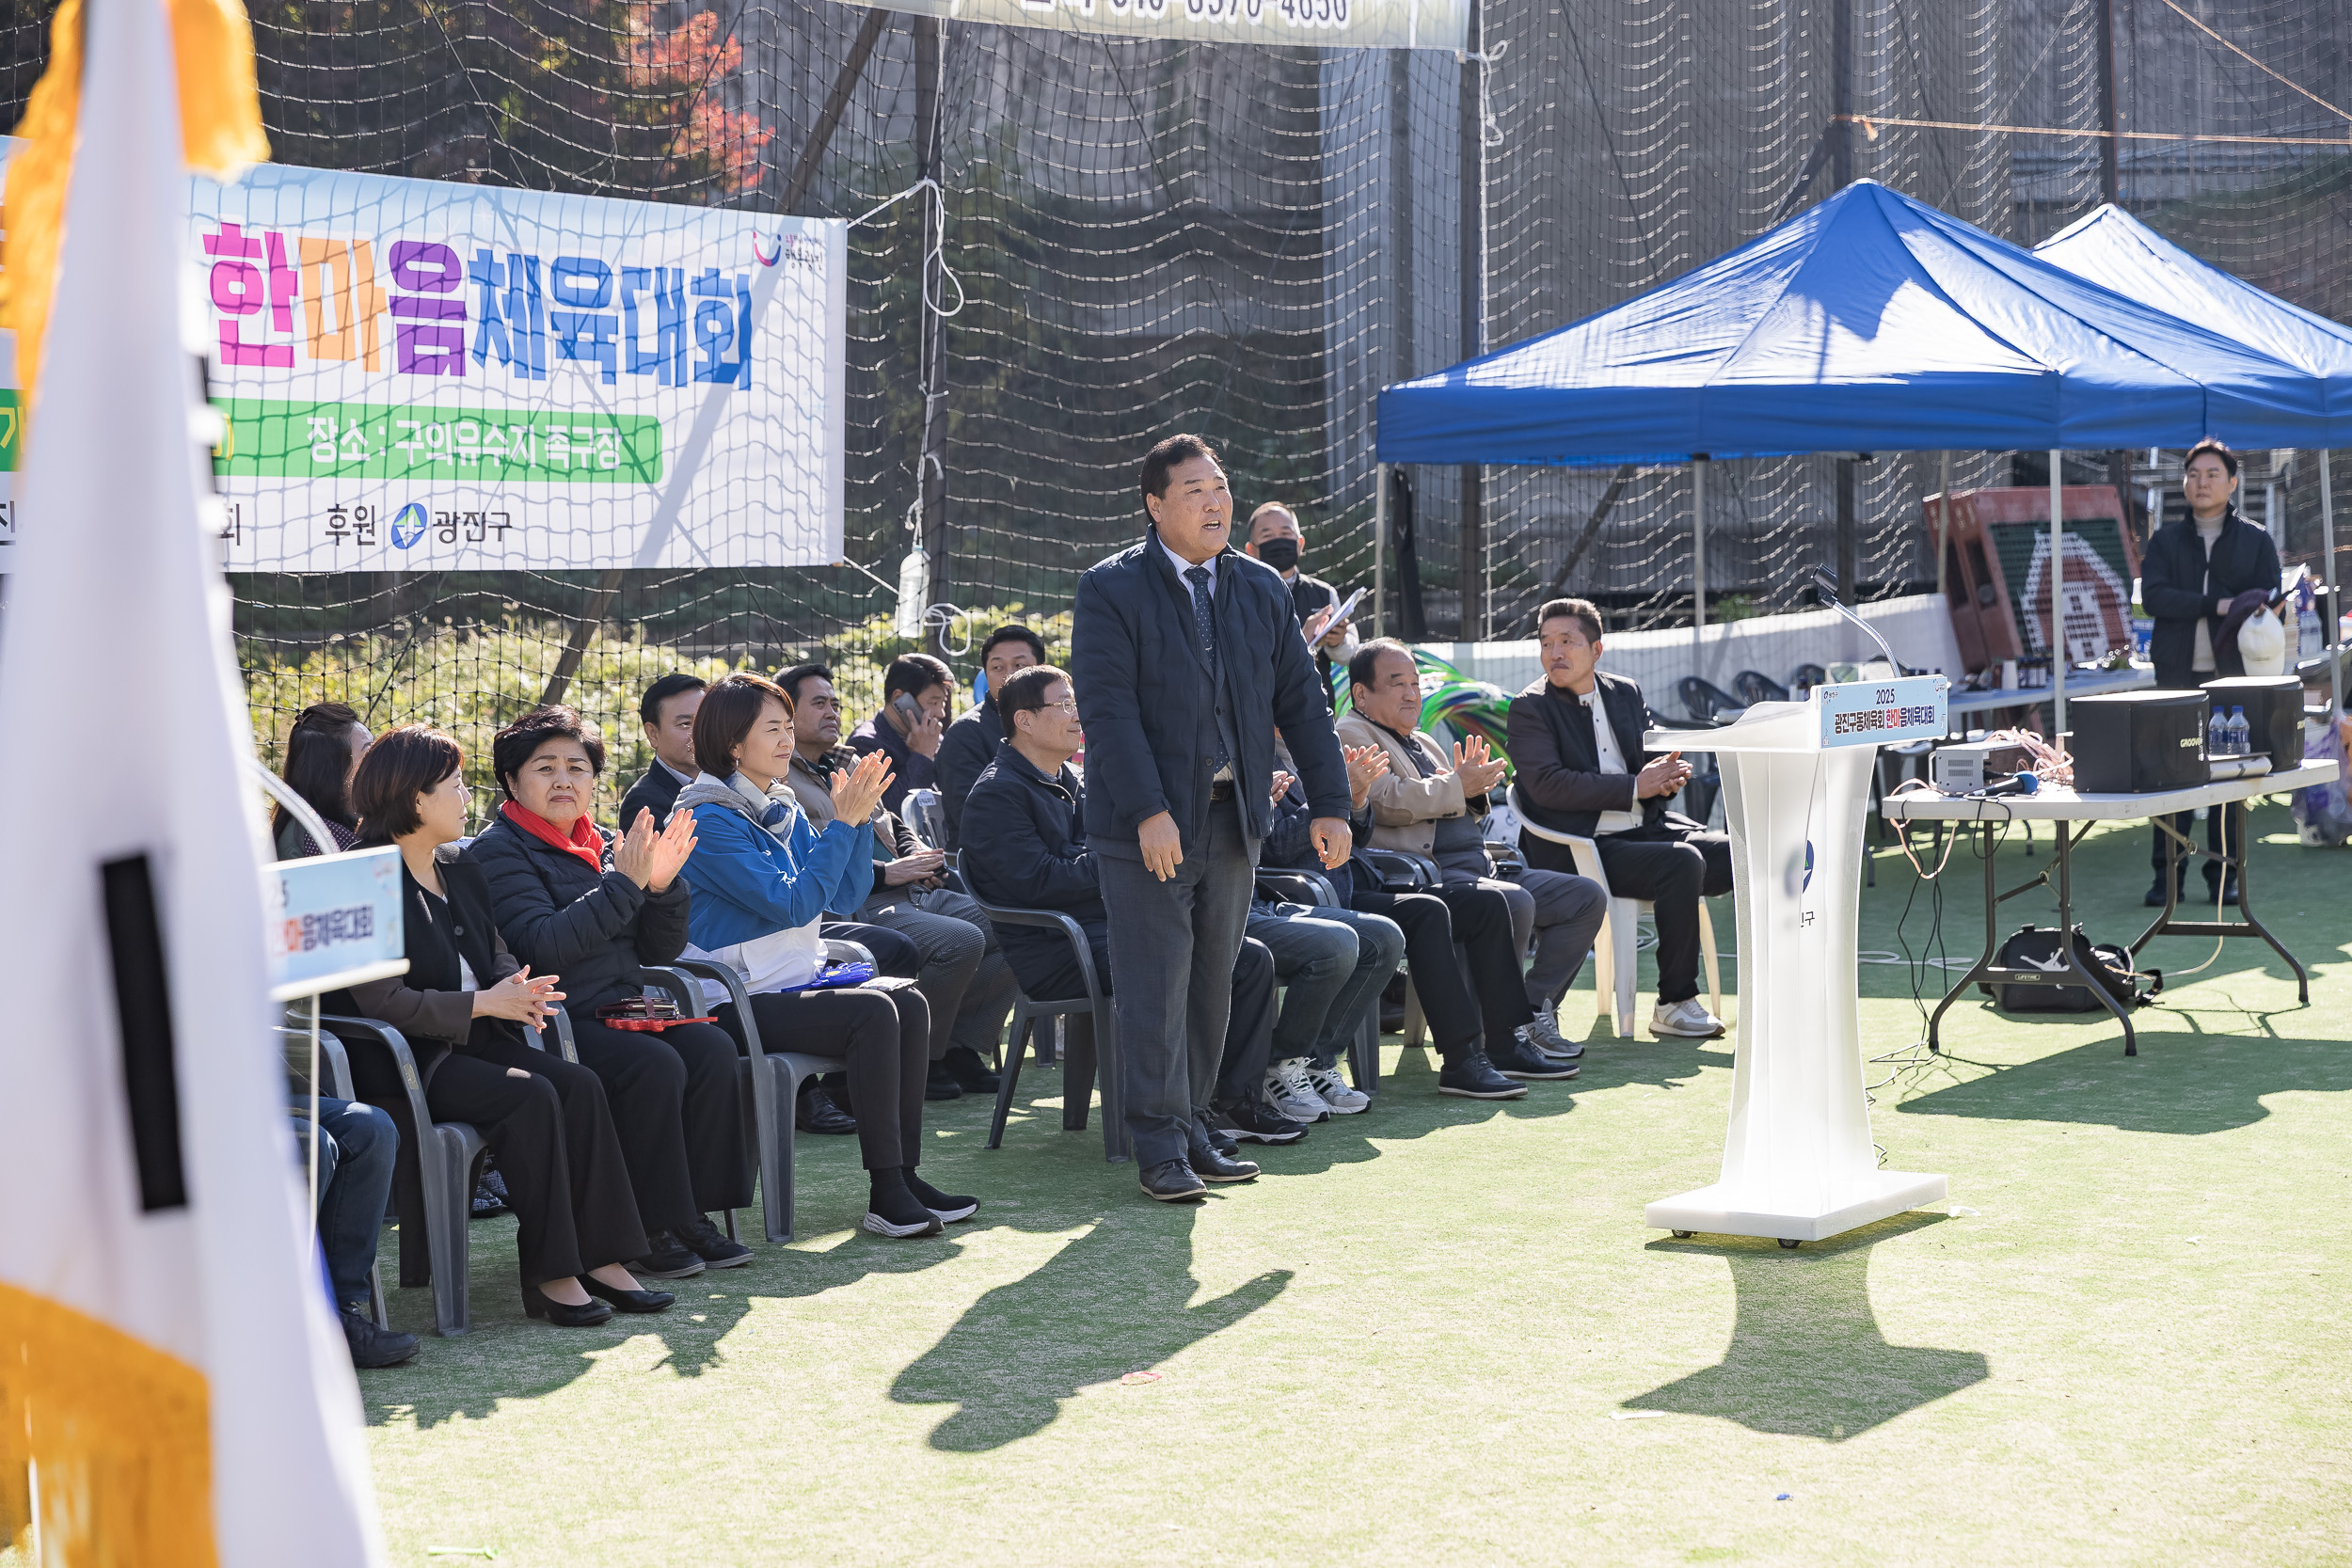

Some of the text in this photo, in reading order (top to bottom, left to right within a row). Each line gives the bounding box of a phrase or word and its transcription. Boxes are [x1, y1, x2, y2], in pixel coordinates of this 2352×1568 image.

[203, 222, 752, 391] 한마음체육대회
[308, 417, 371, 463] 장소
[395, 420, 536, 468] 구의유수지
[545, 423, 622, 470] 족구장
[325, 503, 513, 546] 후원 광진구
[1876, 689, 1896, 705] 2025
[1835, 705, 1935, 734] 광진구동체육회 한마음체육대회
